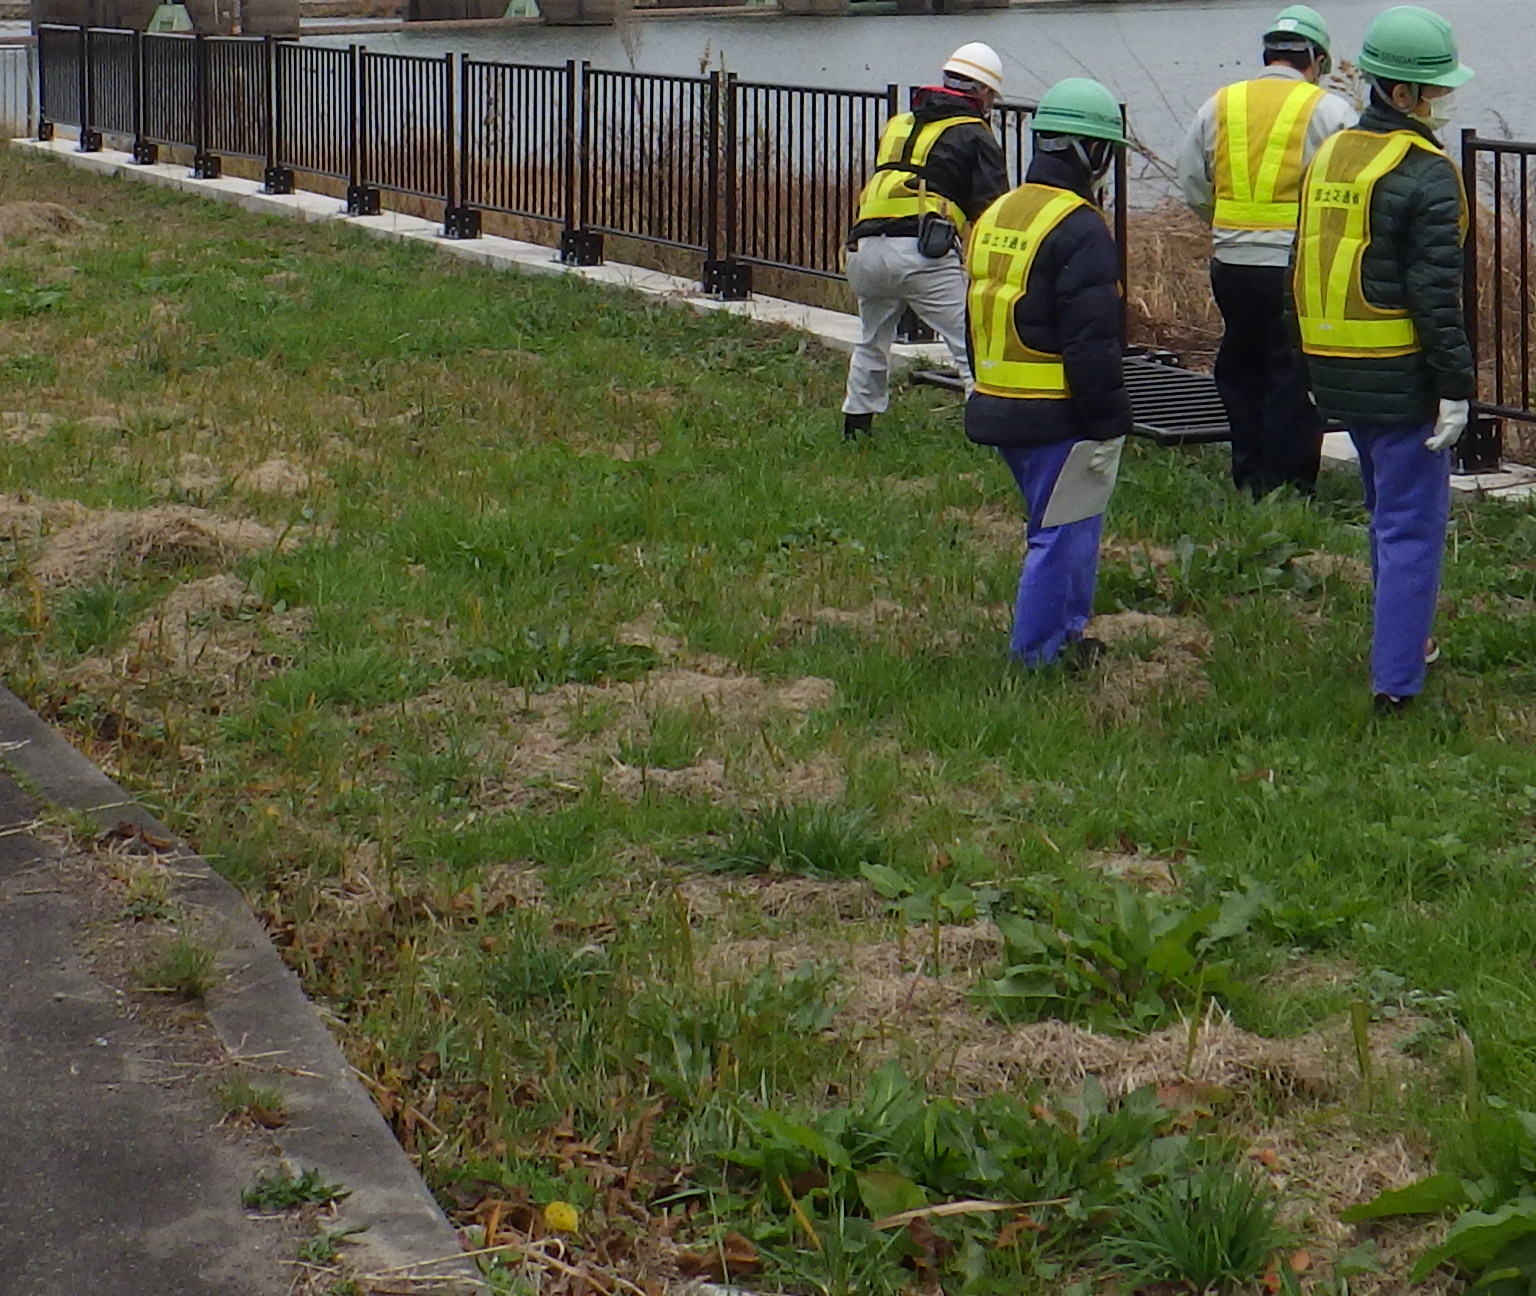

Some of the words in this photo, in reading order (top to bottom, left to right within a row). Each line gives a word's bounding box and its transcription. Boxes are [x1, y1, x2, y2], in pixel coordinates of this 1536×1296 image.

[1314, 188, 1360, 204] 国土交通省
